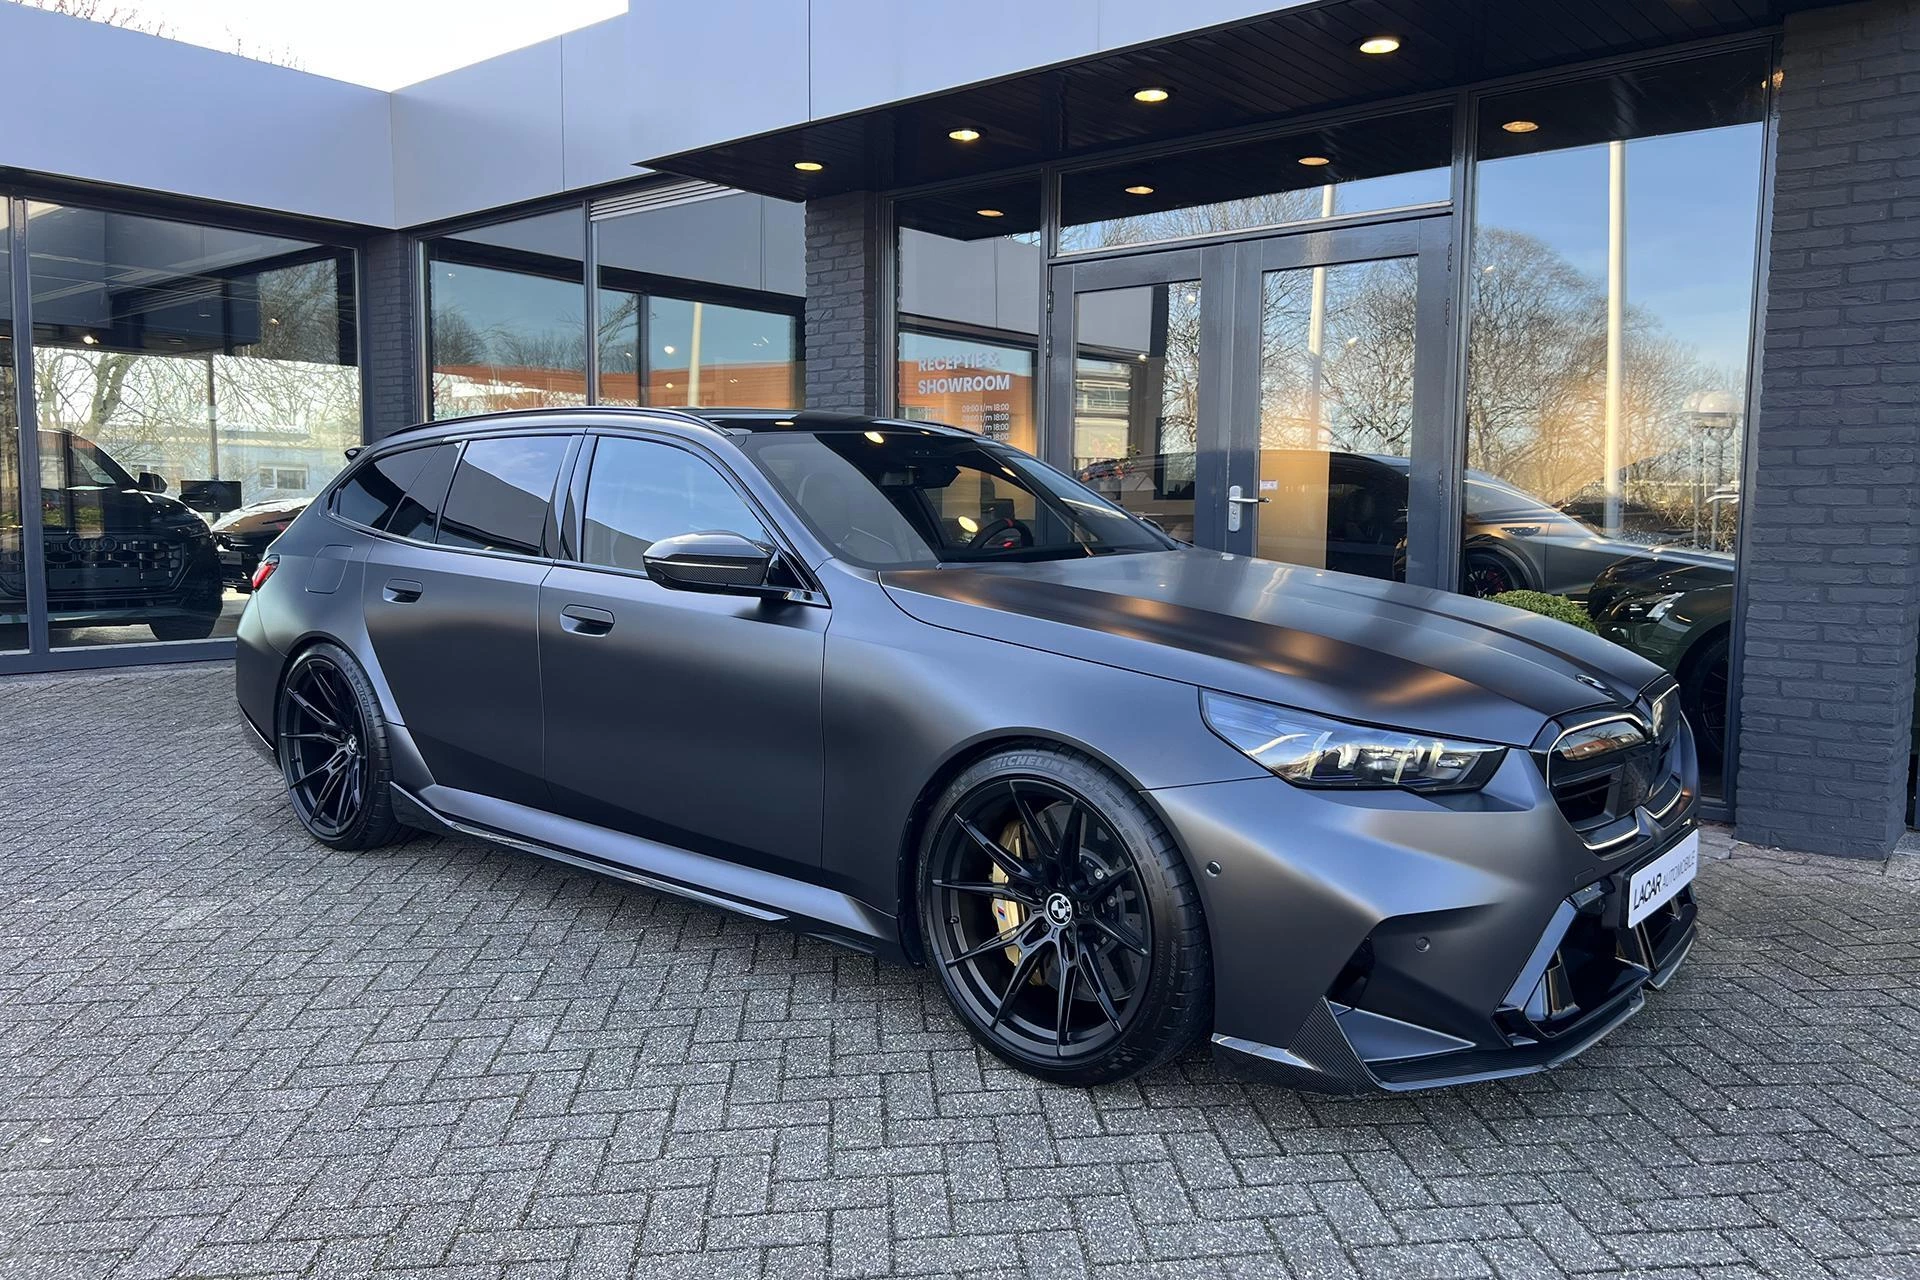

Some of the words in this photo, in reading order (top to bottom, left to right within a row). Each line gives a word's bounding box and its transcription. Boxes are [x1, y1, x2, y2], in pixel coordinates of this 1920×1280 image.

[918, 352, 983, 372] RECEPTIE
[918, 374, 1010, 395] SHOWROOM
[993, 403, 1009, 411] 18:00
[993, 413, 1009, 421] 18:00
[993, 423, 1009, 431] 18:00
[993, 432, 1009, 441] 18:00
[989, 755, 1064, 774] MICHELIN
[1632, 872, 1662, 911] LACAR
